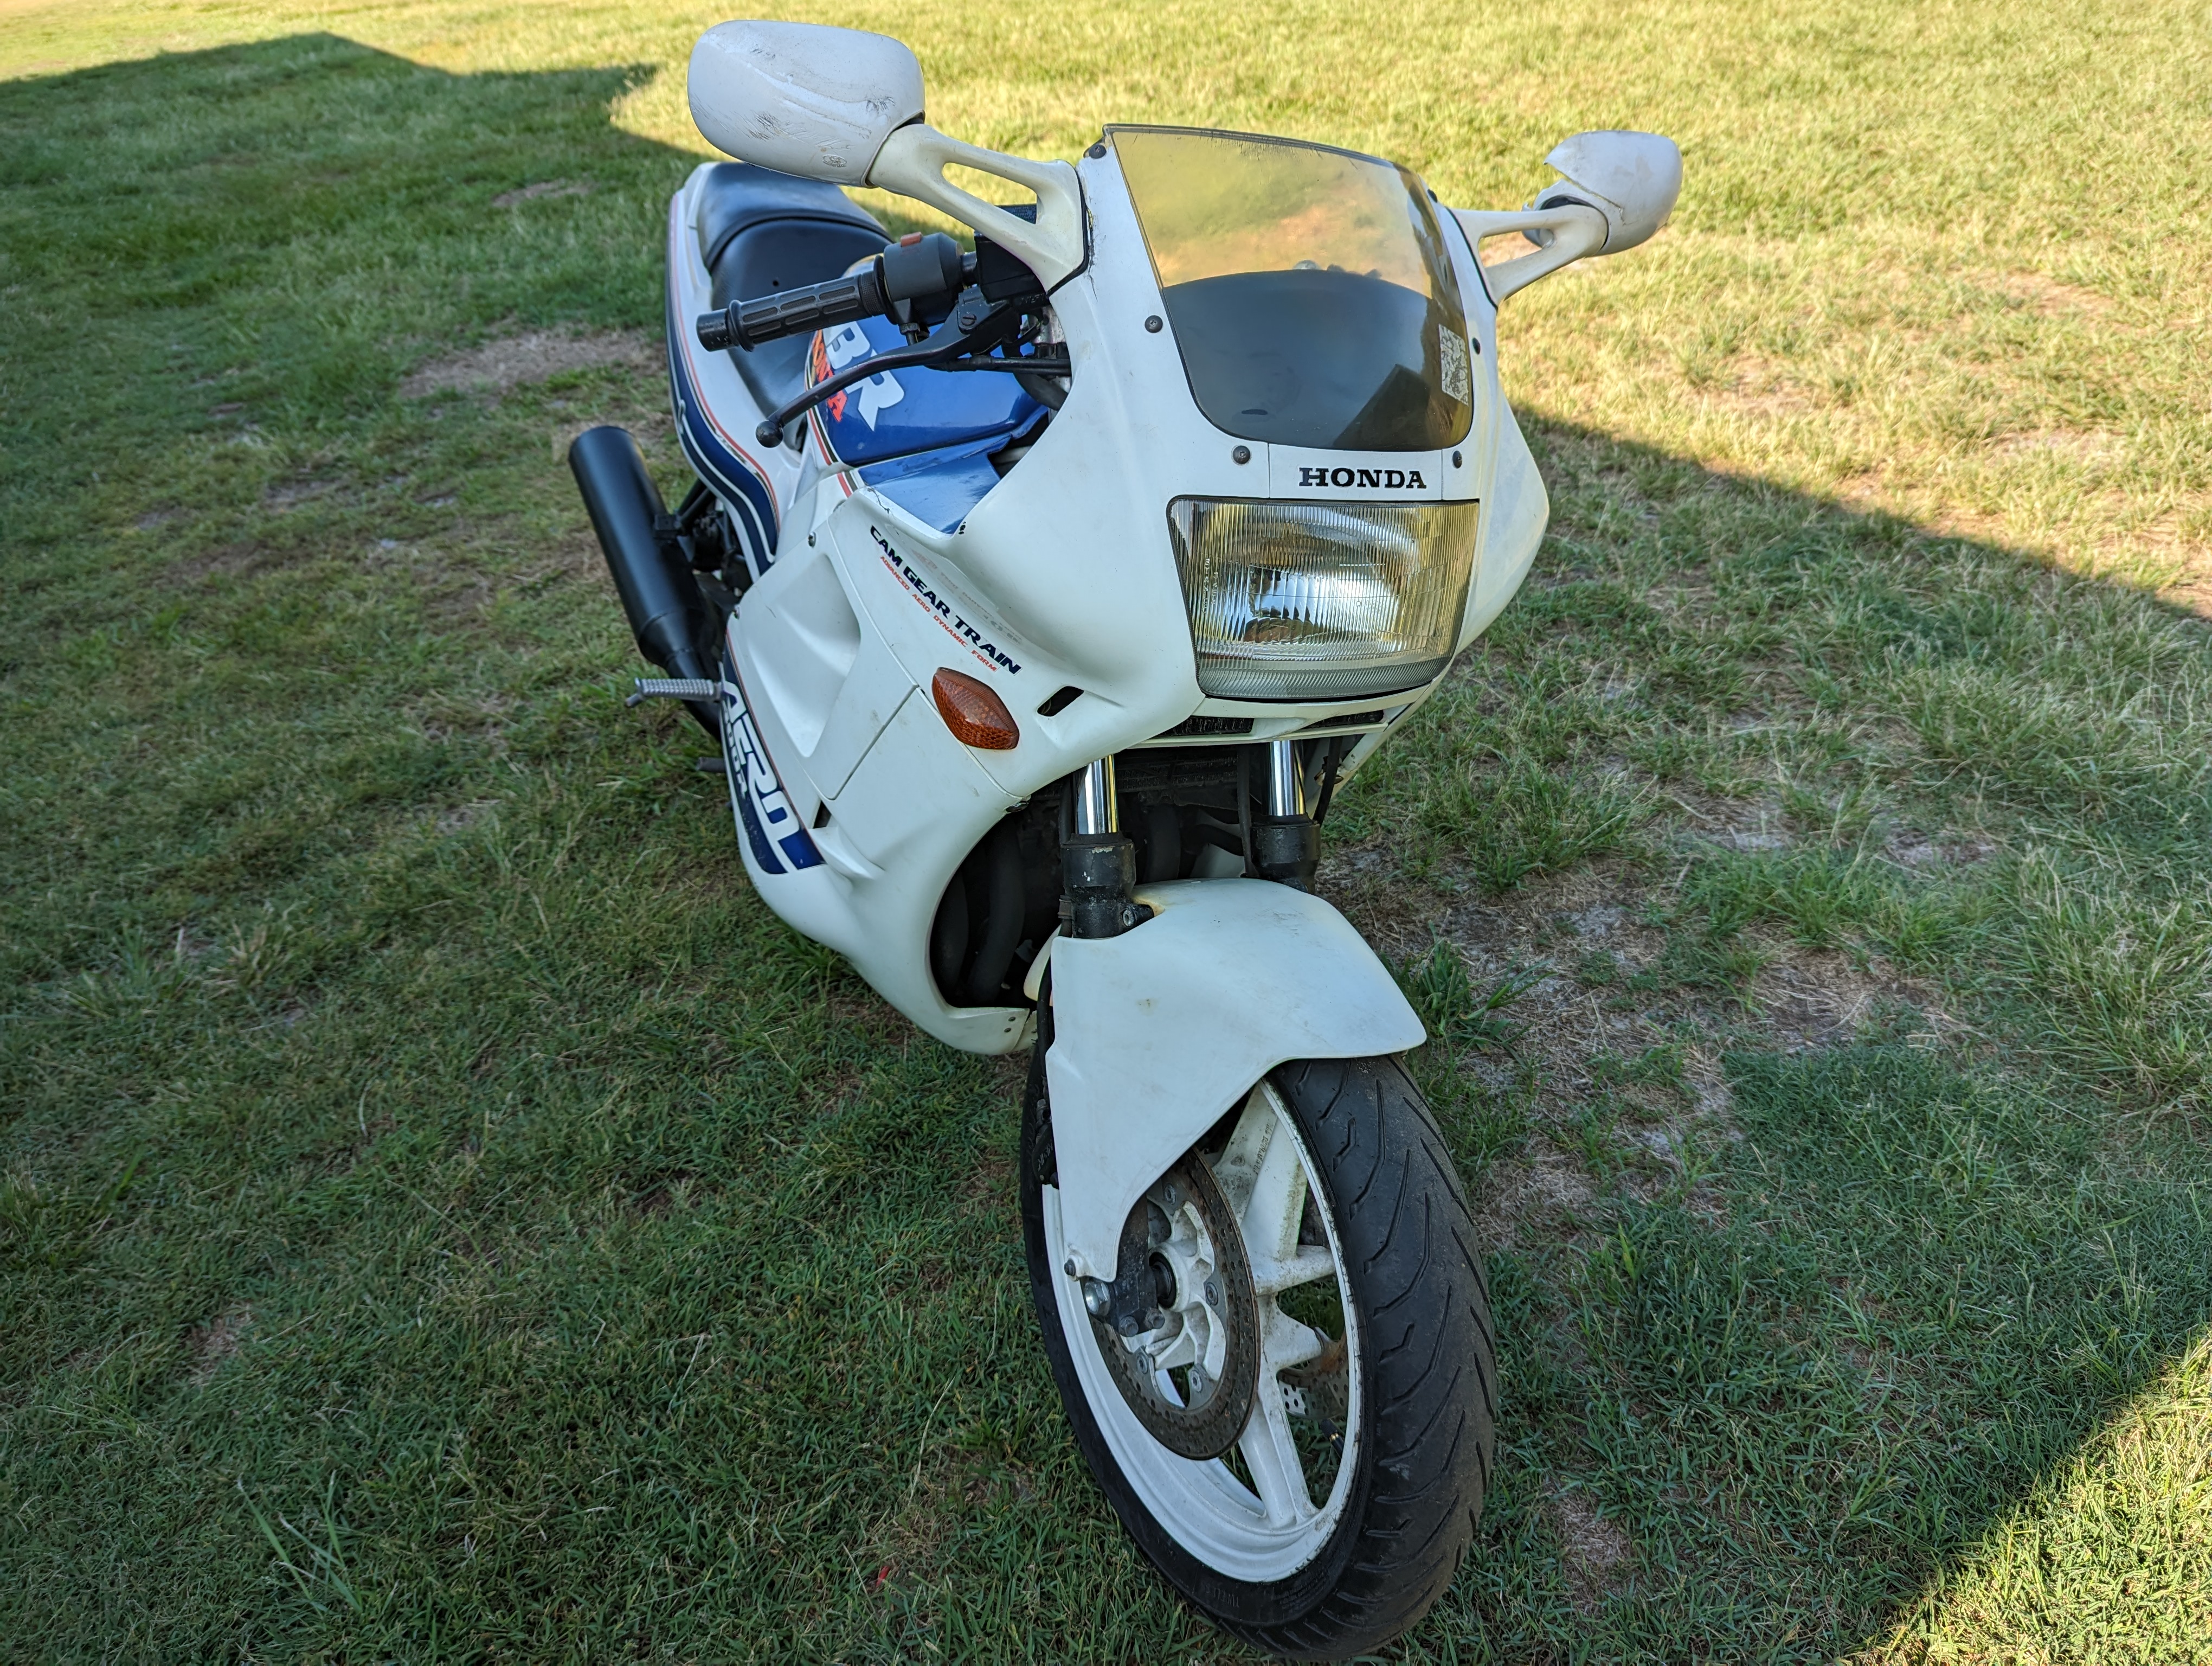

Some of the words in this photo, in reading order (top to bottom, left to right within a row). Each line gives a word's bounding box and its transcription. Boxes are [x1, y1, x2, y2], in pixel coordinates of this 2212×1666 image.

[1299, 467, 1427, 489] HONDA
[870, 525, 903, 567] CAM
[903, 566, 950, 619] GEAR
[953, 615, 1022, 675] TRAIN
[880, 556, 910, 591] ADVANCED
[912, 593, 931, 613] AERO
[933, 615, 968, 648] DYNAMIC
[971, 650, 998, 672] FORM
[721, 679, 800, 843] AERO
